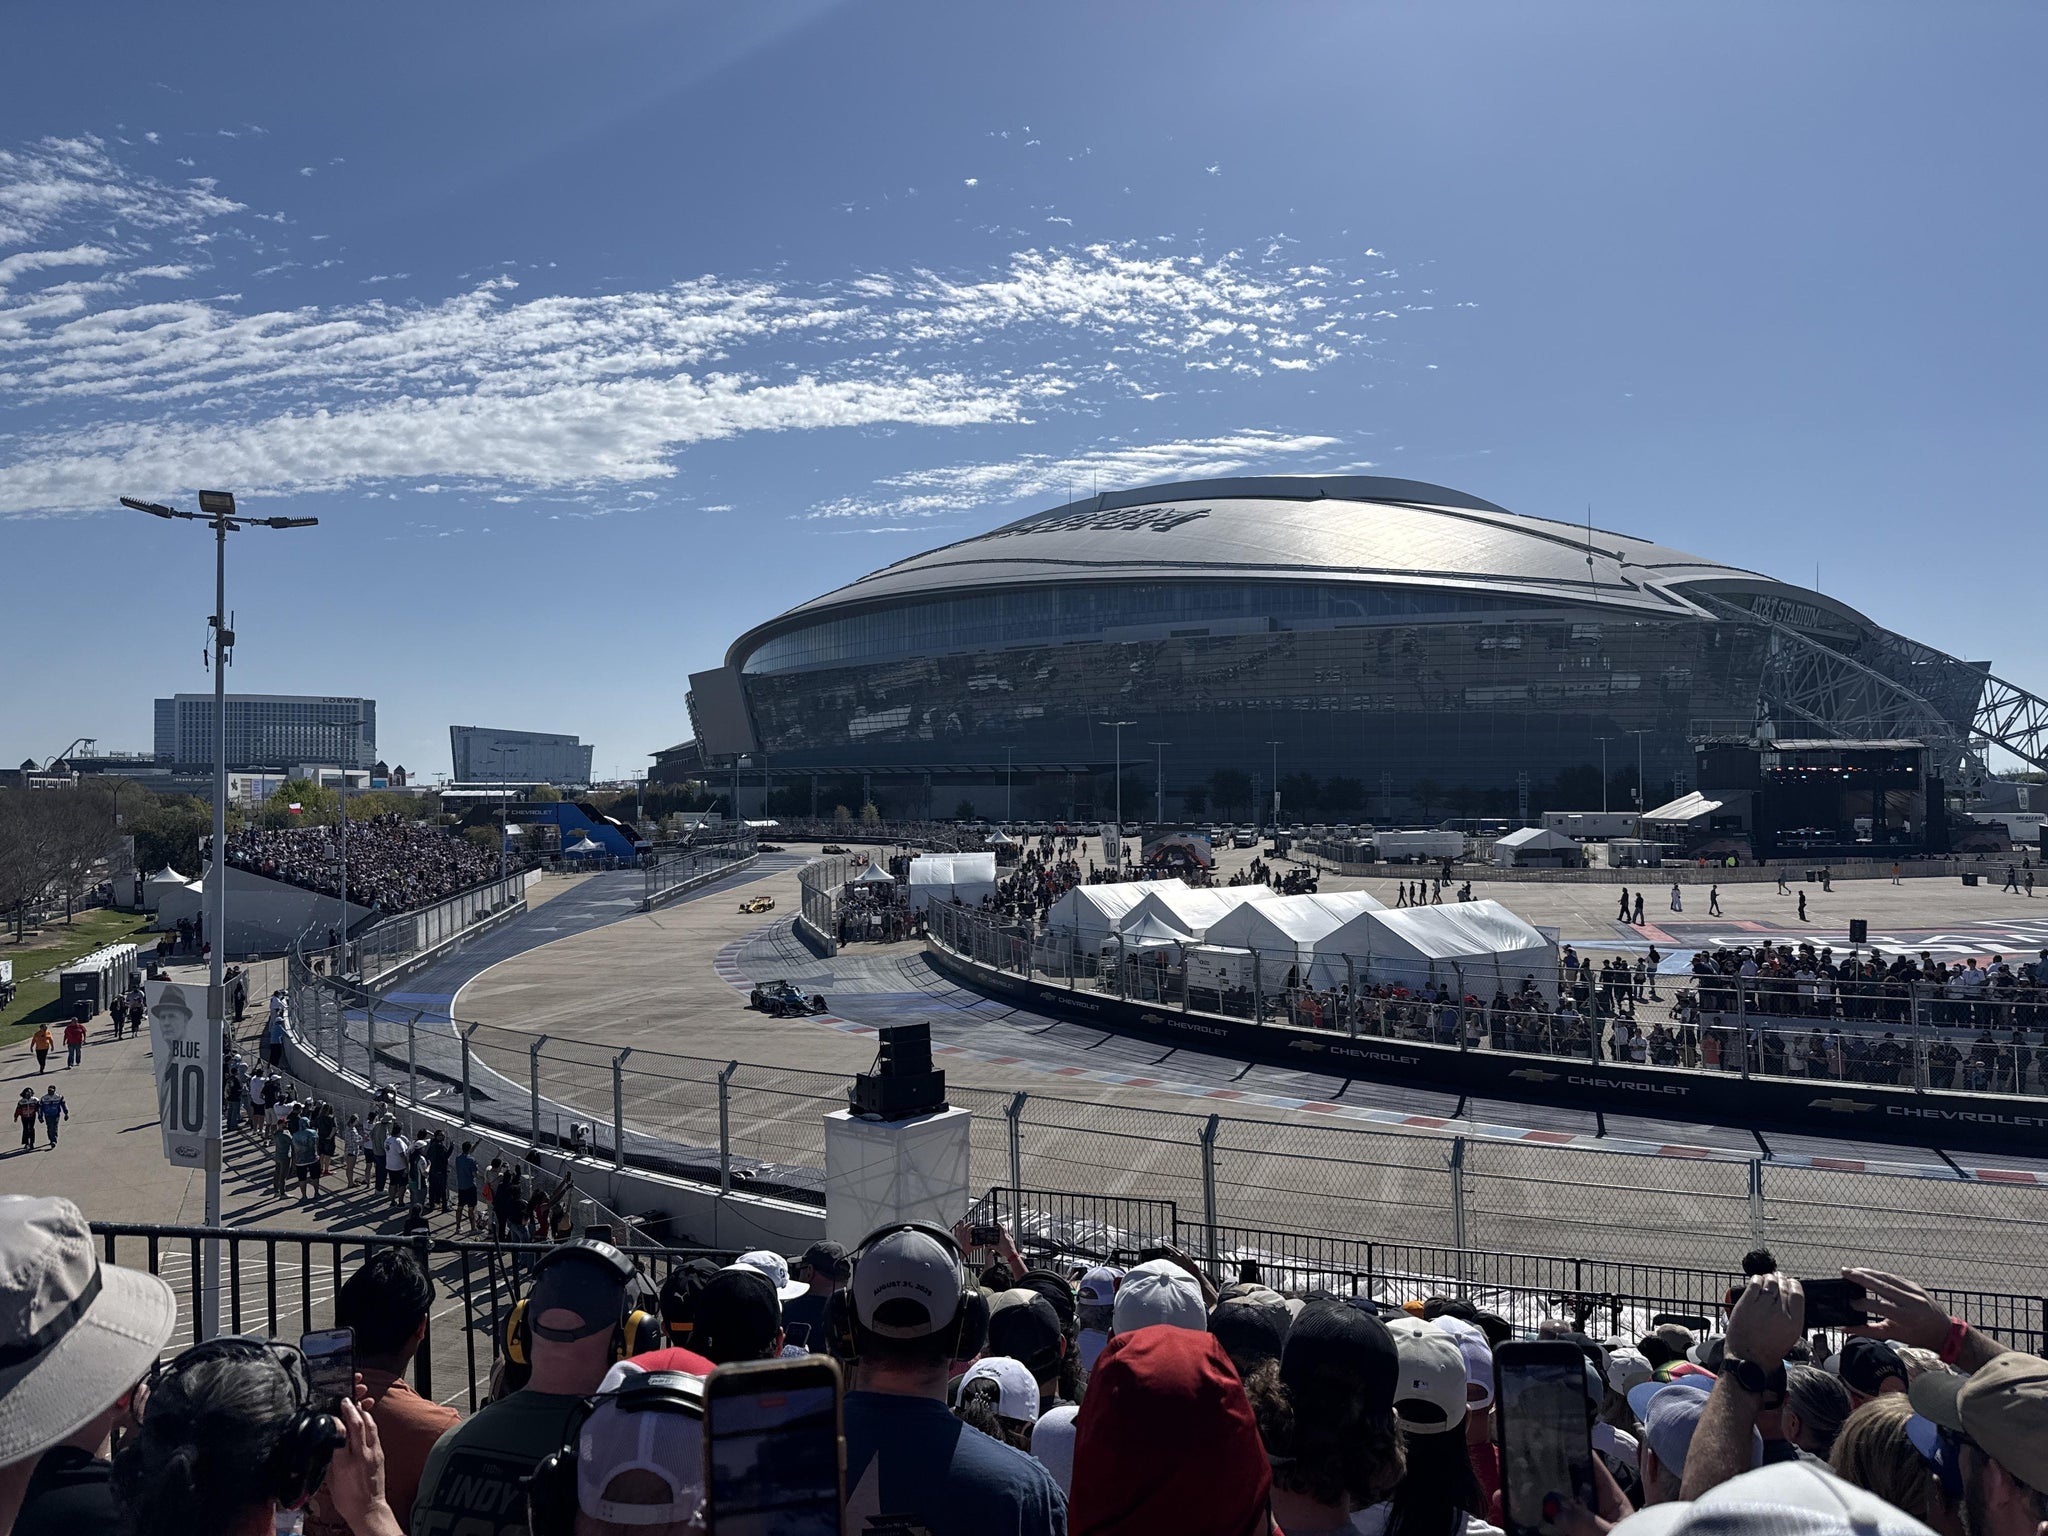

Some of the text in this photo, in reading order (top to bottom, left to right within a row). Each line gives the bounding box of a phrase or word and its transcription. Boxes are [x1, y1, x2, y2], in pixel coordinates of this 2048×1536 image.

[1752, 595, 1821, 628] AT&T STADIUM
[1105, 842, 1117, 858] 10
[1058, 996, 1100, 1012] CHEVROLET
[1167, 1019, 1229, 1037] CHEVROLET
[173, 1040, 200, 1059] BLUE
[1330, 1046, 1420, 1066] CHEVROLET
[1568, 1076, 1690, 1096] CHEVROLET
[165, 1063, 205, 1132] 10
[1886, 1105, 2048, 1128] CHEVROLET
[176, 1147, 199, 1158] Ford
[873, 1281, 901, 1297] AUGUST
[445, 1474, 519, 1515] INDY
